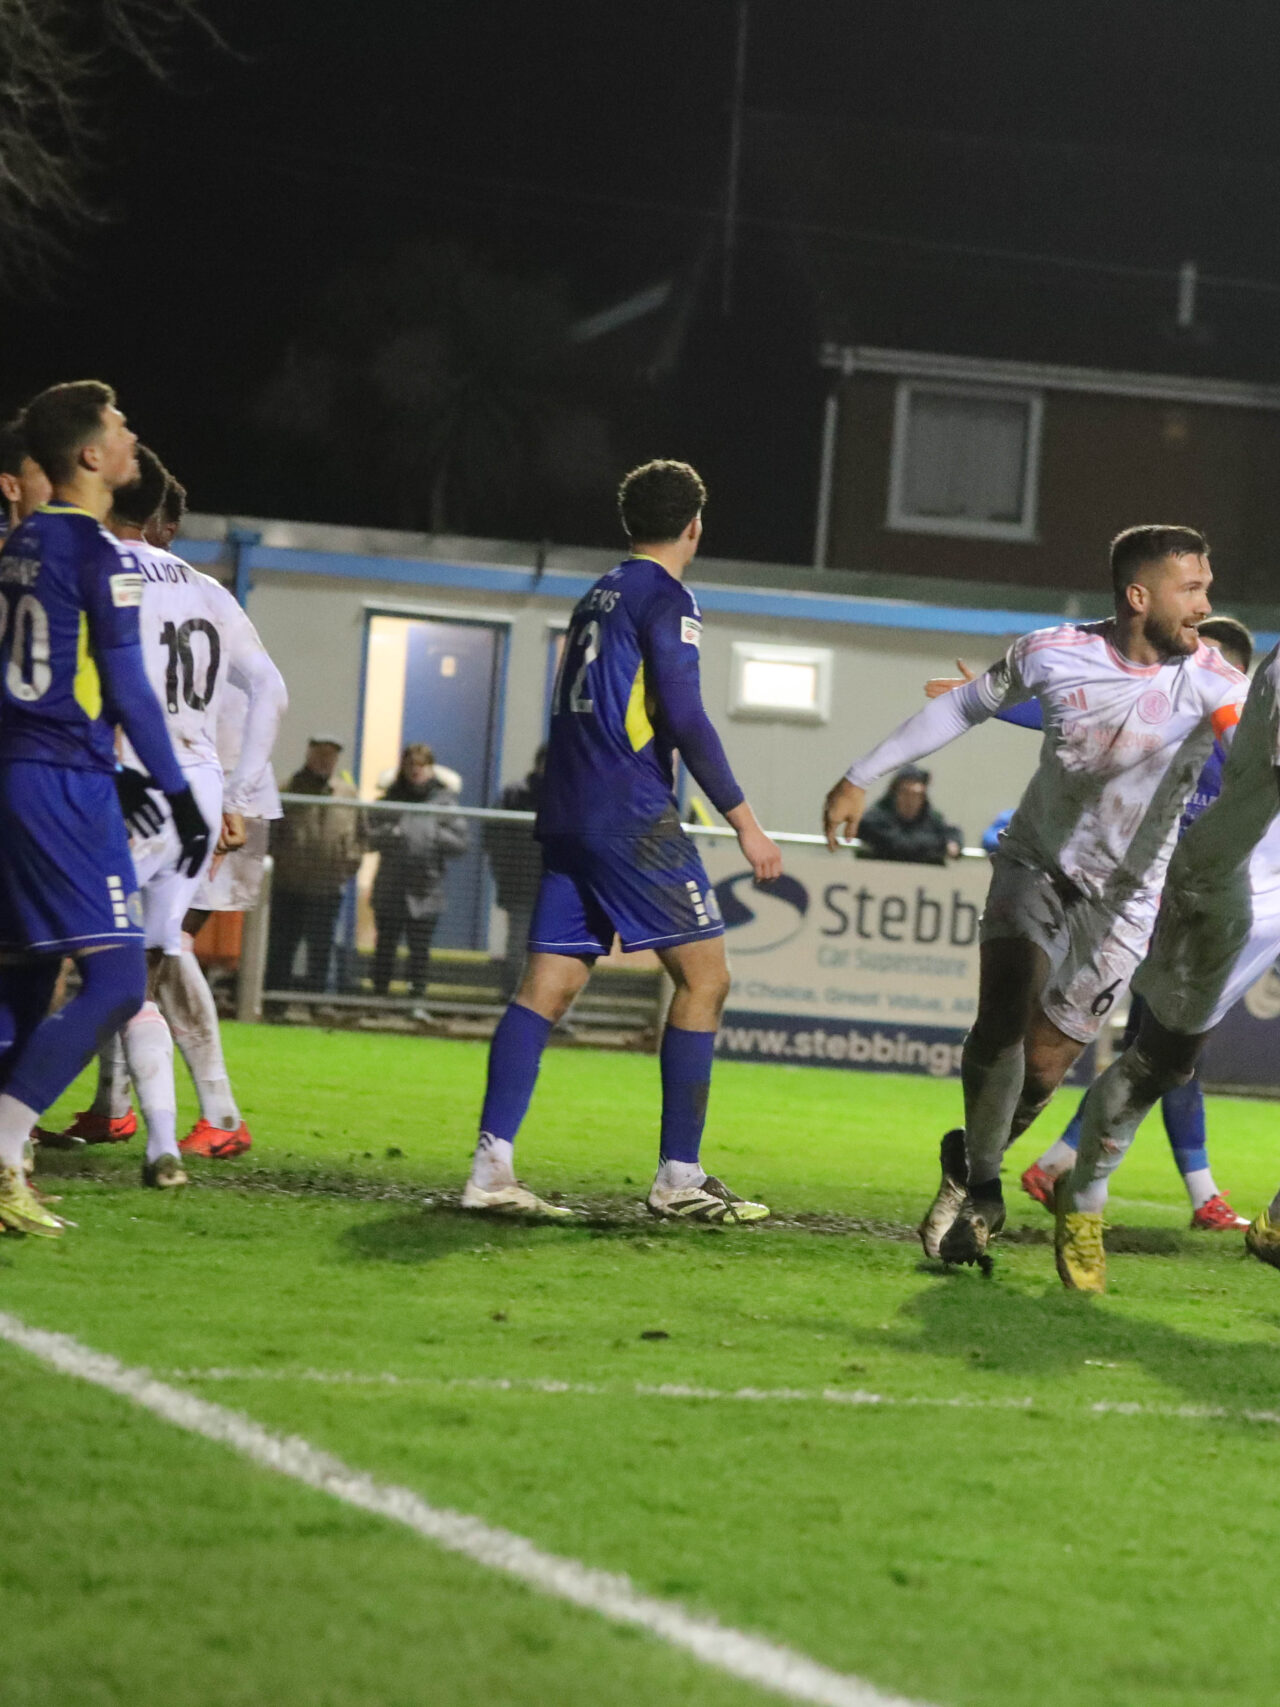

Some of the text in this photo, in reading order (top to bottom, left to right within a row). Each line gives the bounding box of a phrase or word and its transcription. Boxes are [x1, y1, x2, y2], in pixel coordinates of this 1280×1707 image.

[142, 563, 190, 583] LLIOT
[160, 617, 221, 714] 10
[821, 884, 979, 946] Stebb
[1091, 978, 1124, 1016] 6
